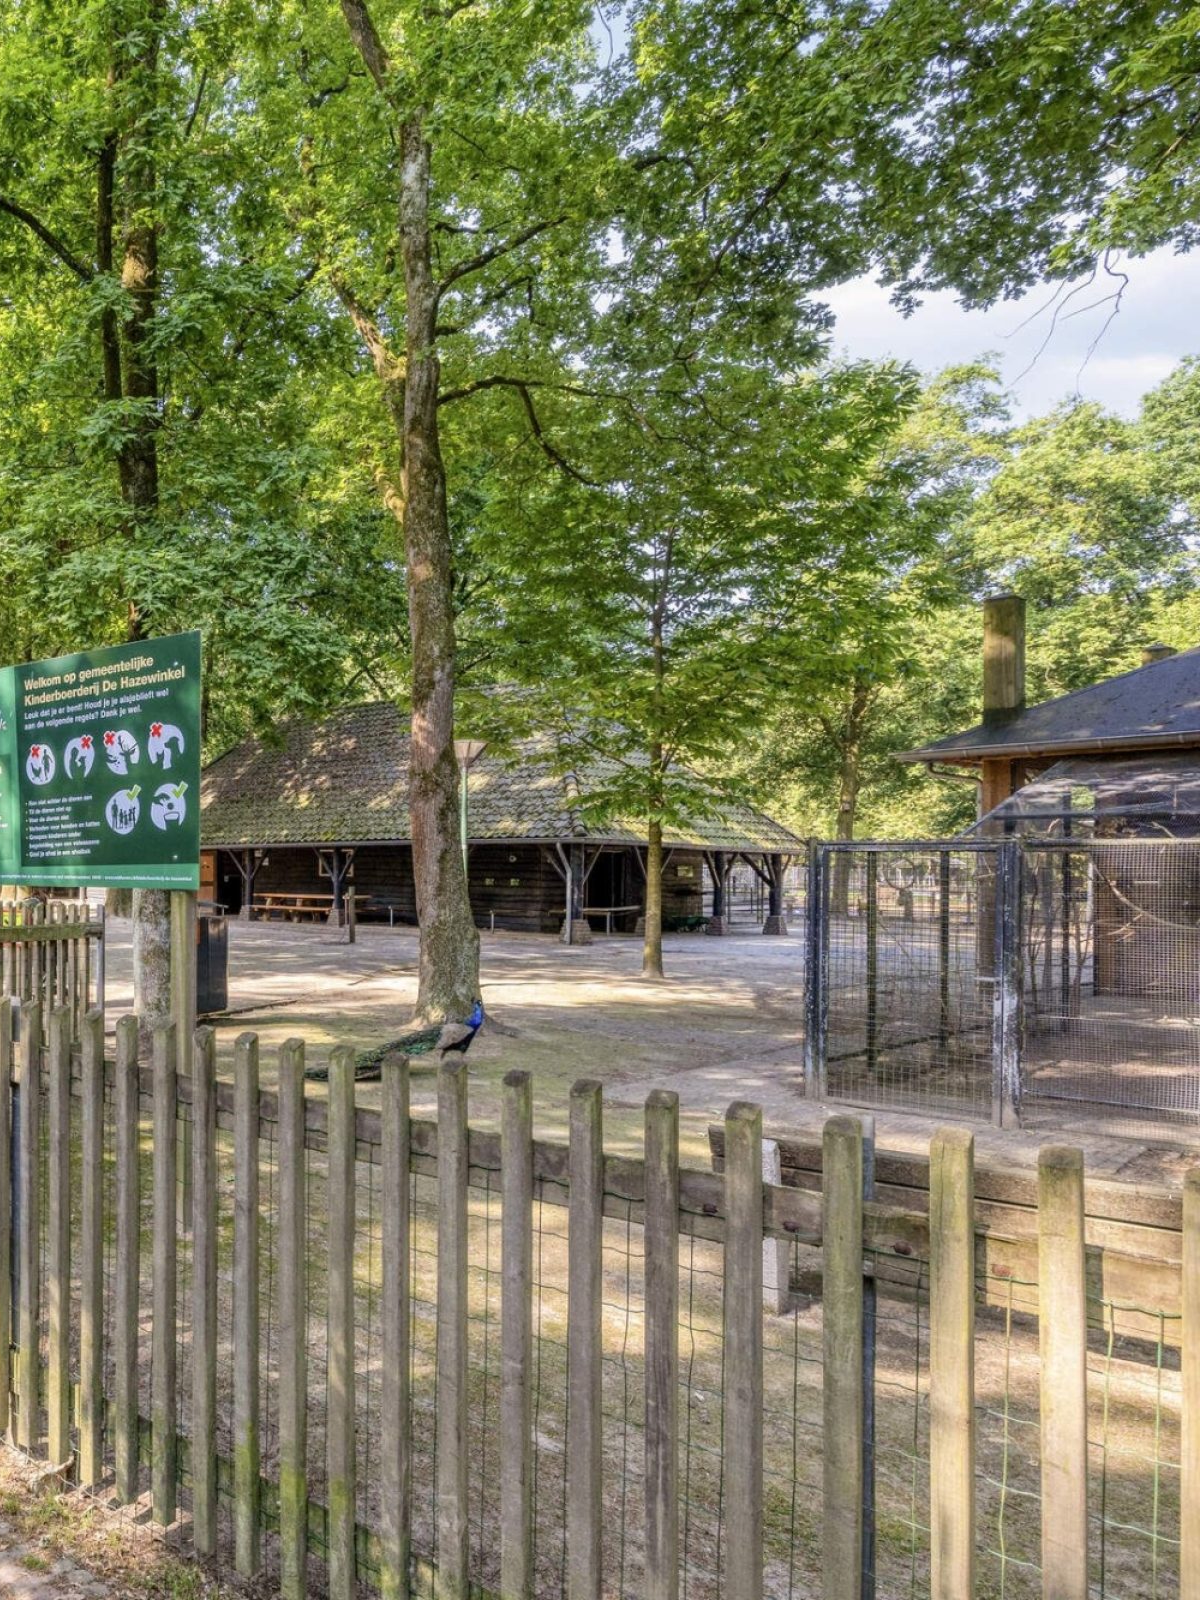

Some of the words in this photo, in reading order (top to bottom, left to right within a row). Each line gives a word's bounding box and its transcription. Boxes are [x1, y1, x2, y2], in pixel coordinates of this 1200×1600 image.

[24, 675, 61, 690] Welkom
[64, 672, 76, 685] op
[80, 656, 154, 681] gemeentelijke
[24, 683, 100, 706] Kinderboerderij
[103, 680, 117, 692] De
[121, 665, 185, 689] Hazewinkel
[24, 711, 38, 720] Leuk
[40, 709, 50, 718] dat
[51, 708, 57, 717] je
[84, 700, 102, 711] Houd
[103, 698, 110, 708] je
[120, 691, 154, 706] alsjeblieft
[37, 720, 44, 728] de
[46, 716, 73, 728] volgende
[75, 711, 98, 724] regels?
[100, 708, 118, 719] Dank
[119, 707, 126, 717] je
